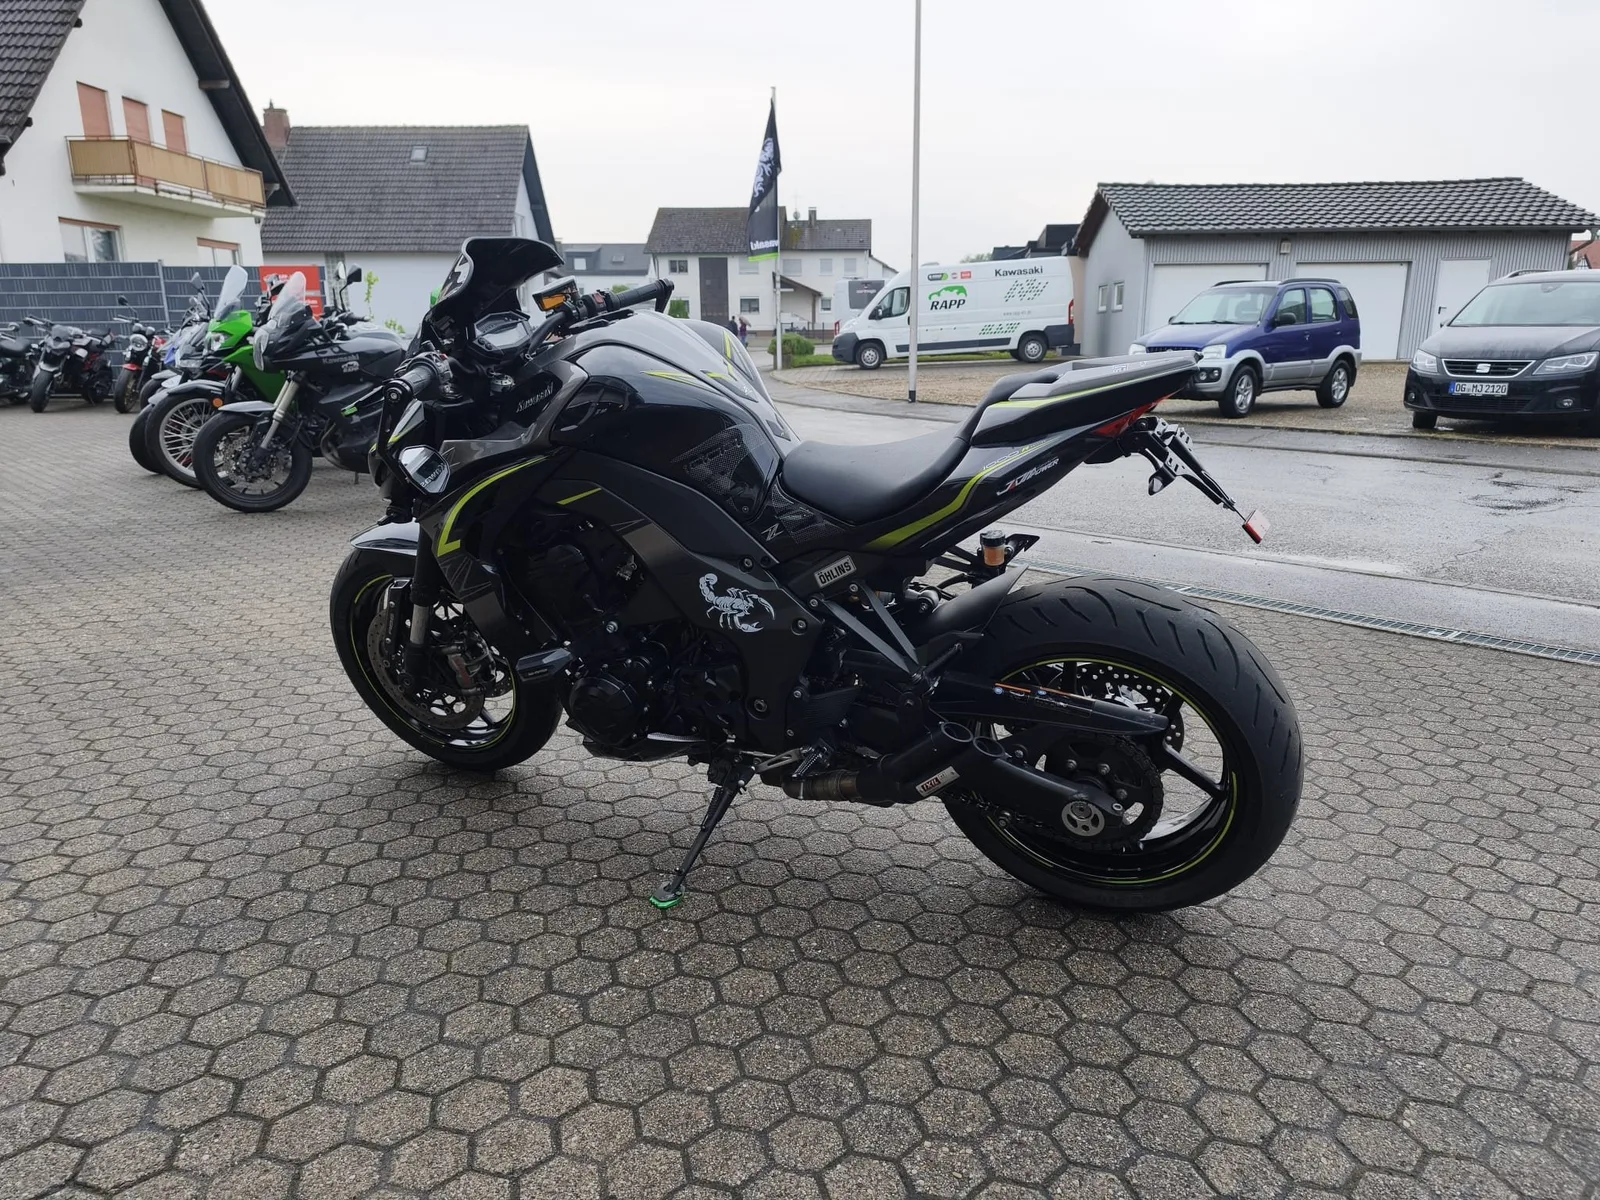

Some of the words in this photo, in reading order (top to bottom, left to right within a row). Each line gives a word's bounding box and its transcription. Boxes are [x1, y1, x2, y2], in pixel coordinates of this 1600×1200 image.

[995, 265, 1043, 278] Kawasaki
[930, 299, 966, 311] RAPP
[322, 353, 360, 364] Kawasaki
[1455, 383, 1466, 392] OG
[1472, 384, 1483, 393] MJ
[1485, 384, 1507, 394] 2120
[818, 561, 852, 585] ÖHLINS
